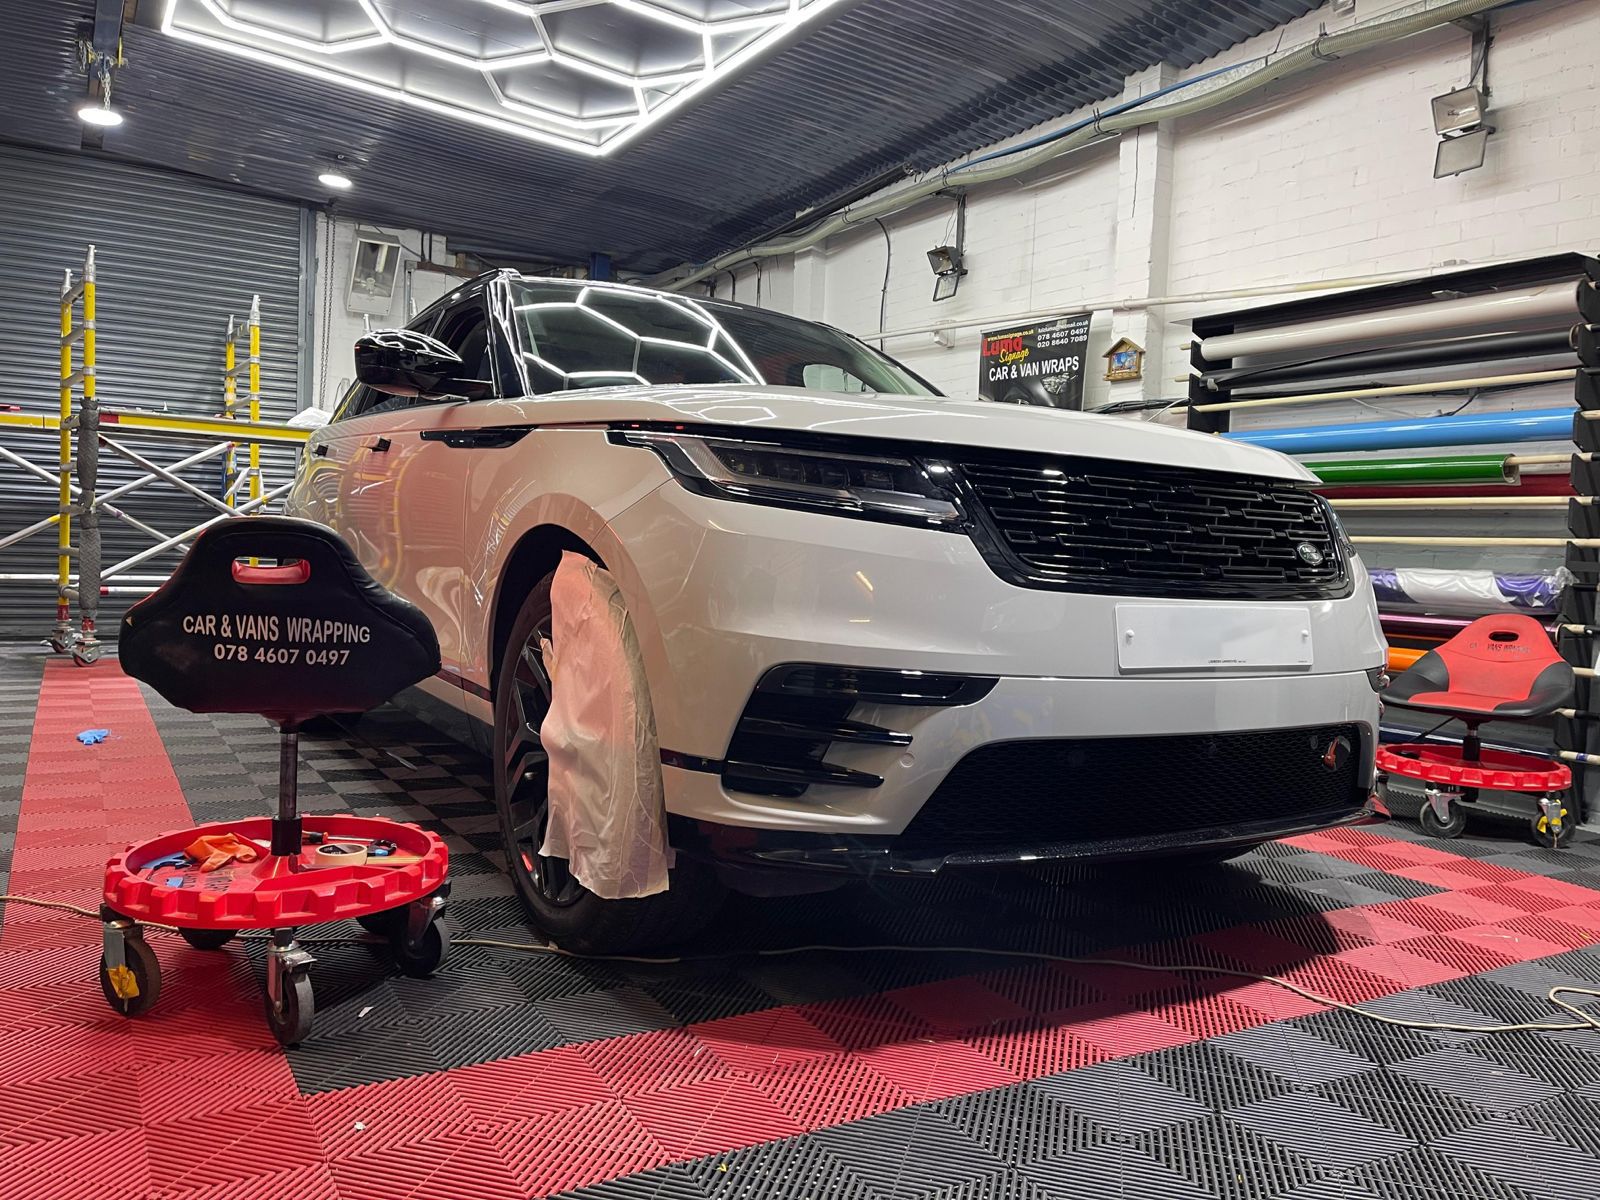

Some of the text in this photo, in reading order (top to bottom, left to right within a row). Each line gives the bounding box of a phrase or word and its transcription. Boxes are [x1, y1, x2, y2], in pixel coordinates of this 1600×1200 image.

[1051, 337, 1069, 346] 8640
[1070, 335, 1088, 343] 7089
[1070, 327, 1088, 336] 0497
[982, 337, 1023, 356] Luma
[999, 348, 1029, 366] Signage
[989, 356, 1080, 382] CAR & VAN WRAPS
[183, 614, 371, 643] CAR & VANS WRAPPING
[214, 643, 350, 665] 078 4607 0497
